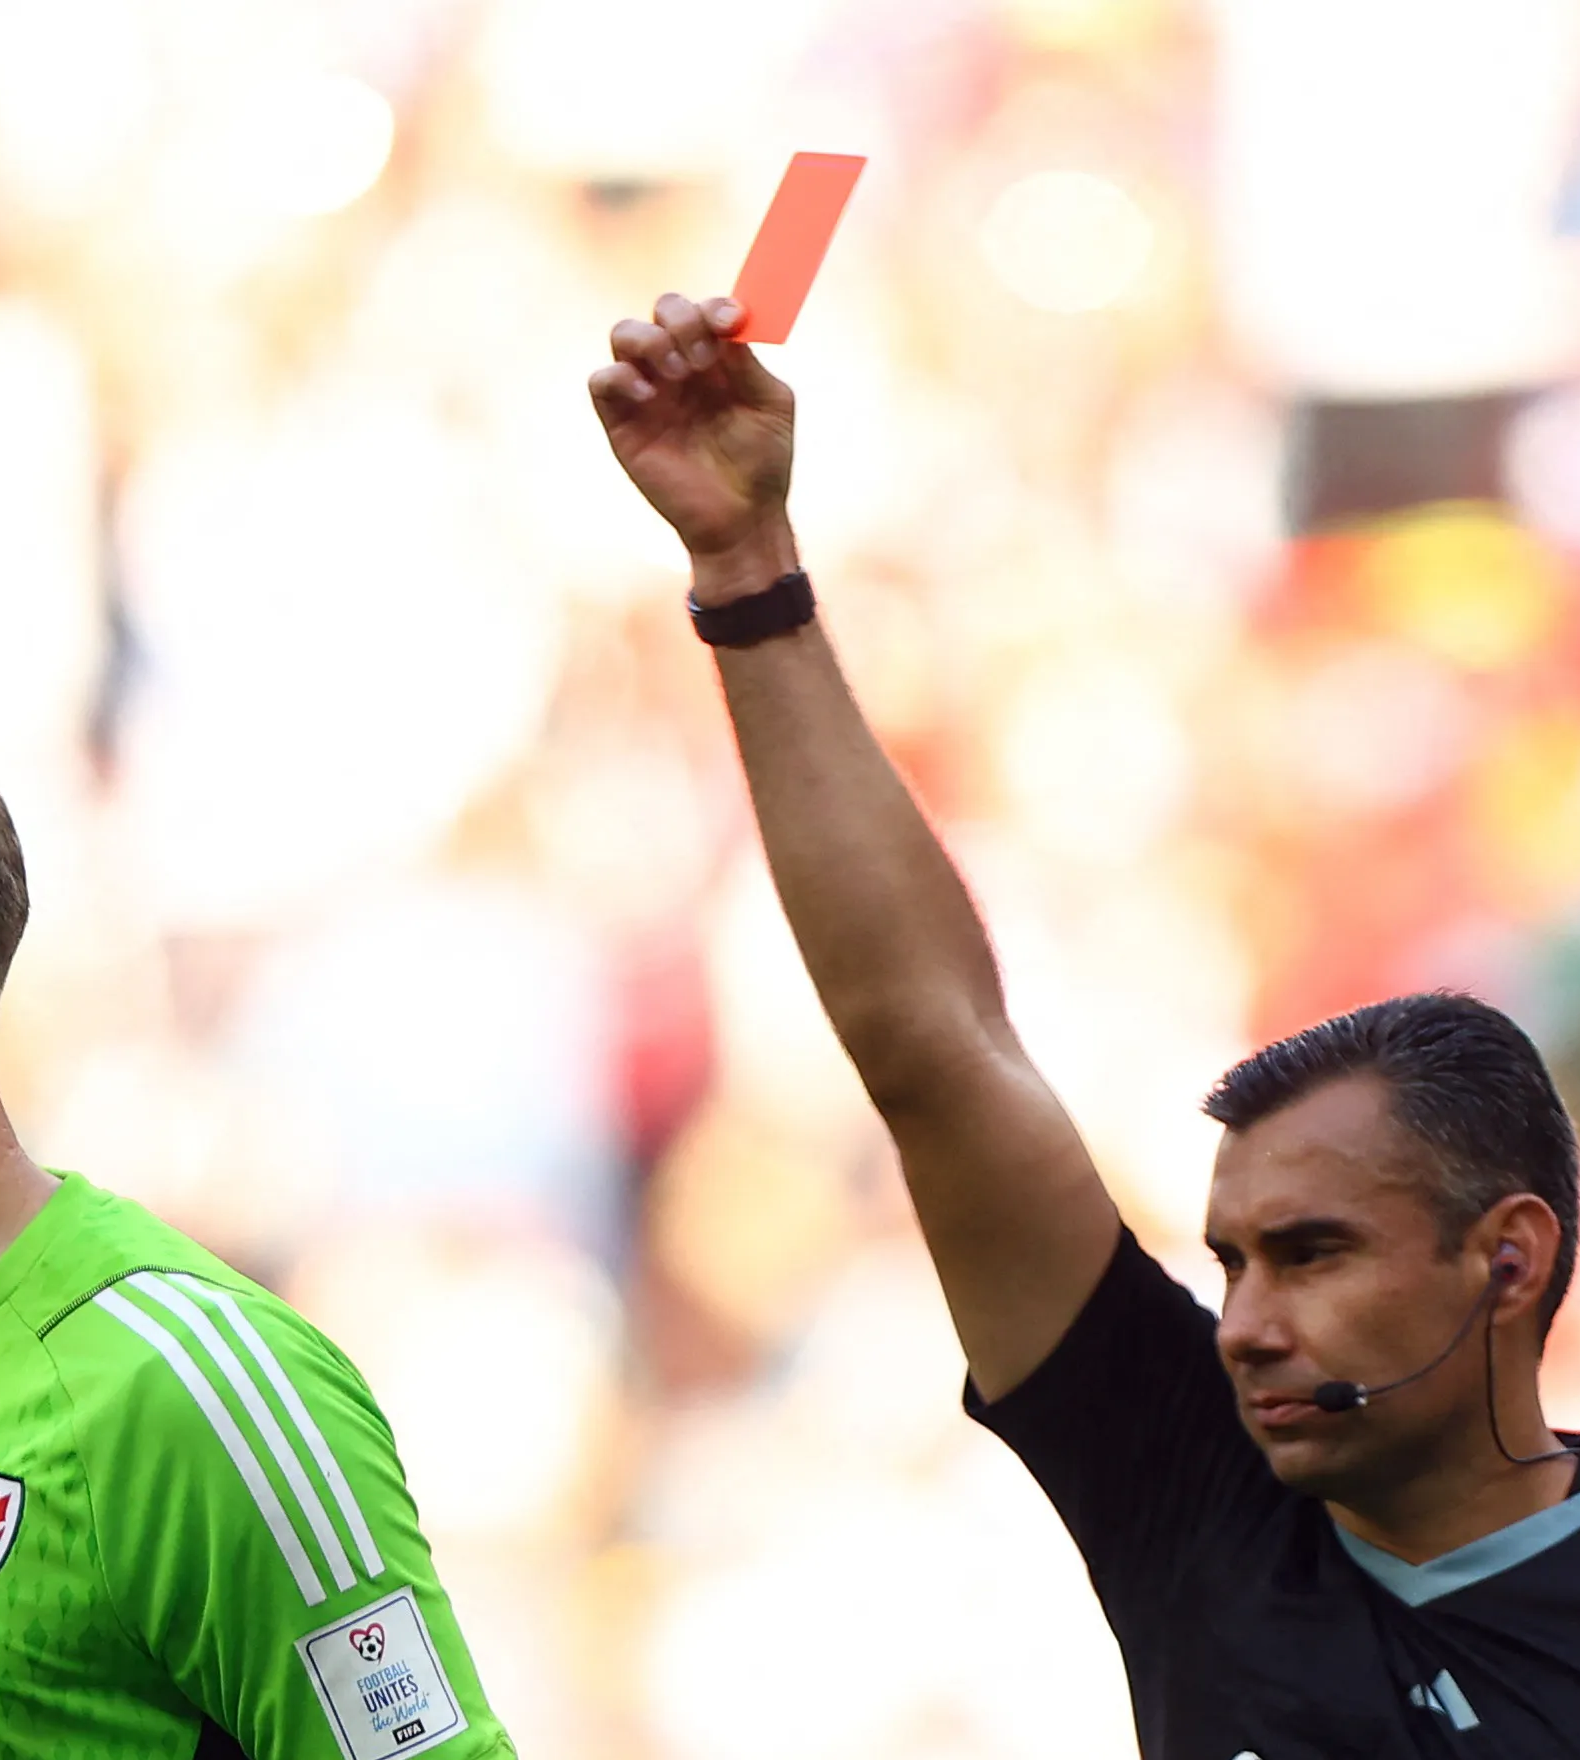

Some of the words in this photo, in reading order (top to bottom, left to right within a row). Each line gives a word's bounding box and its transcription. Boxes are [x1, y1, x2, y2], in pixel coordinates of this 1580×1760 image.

[357, 1659, 411, 1694] FOOTBALL
[363, 1674, 419, 1713] UNITES
[370, 1713, 393, 1732] the
[393, 1690, 429, 1723] World
[396, 1722, 422, 1741] FIFA
